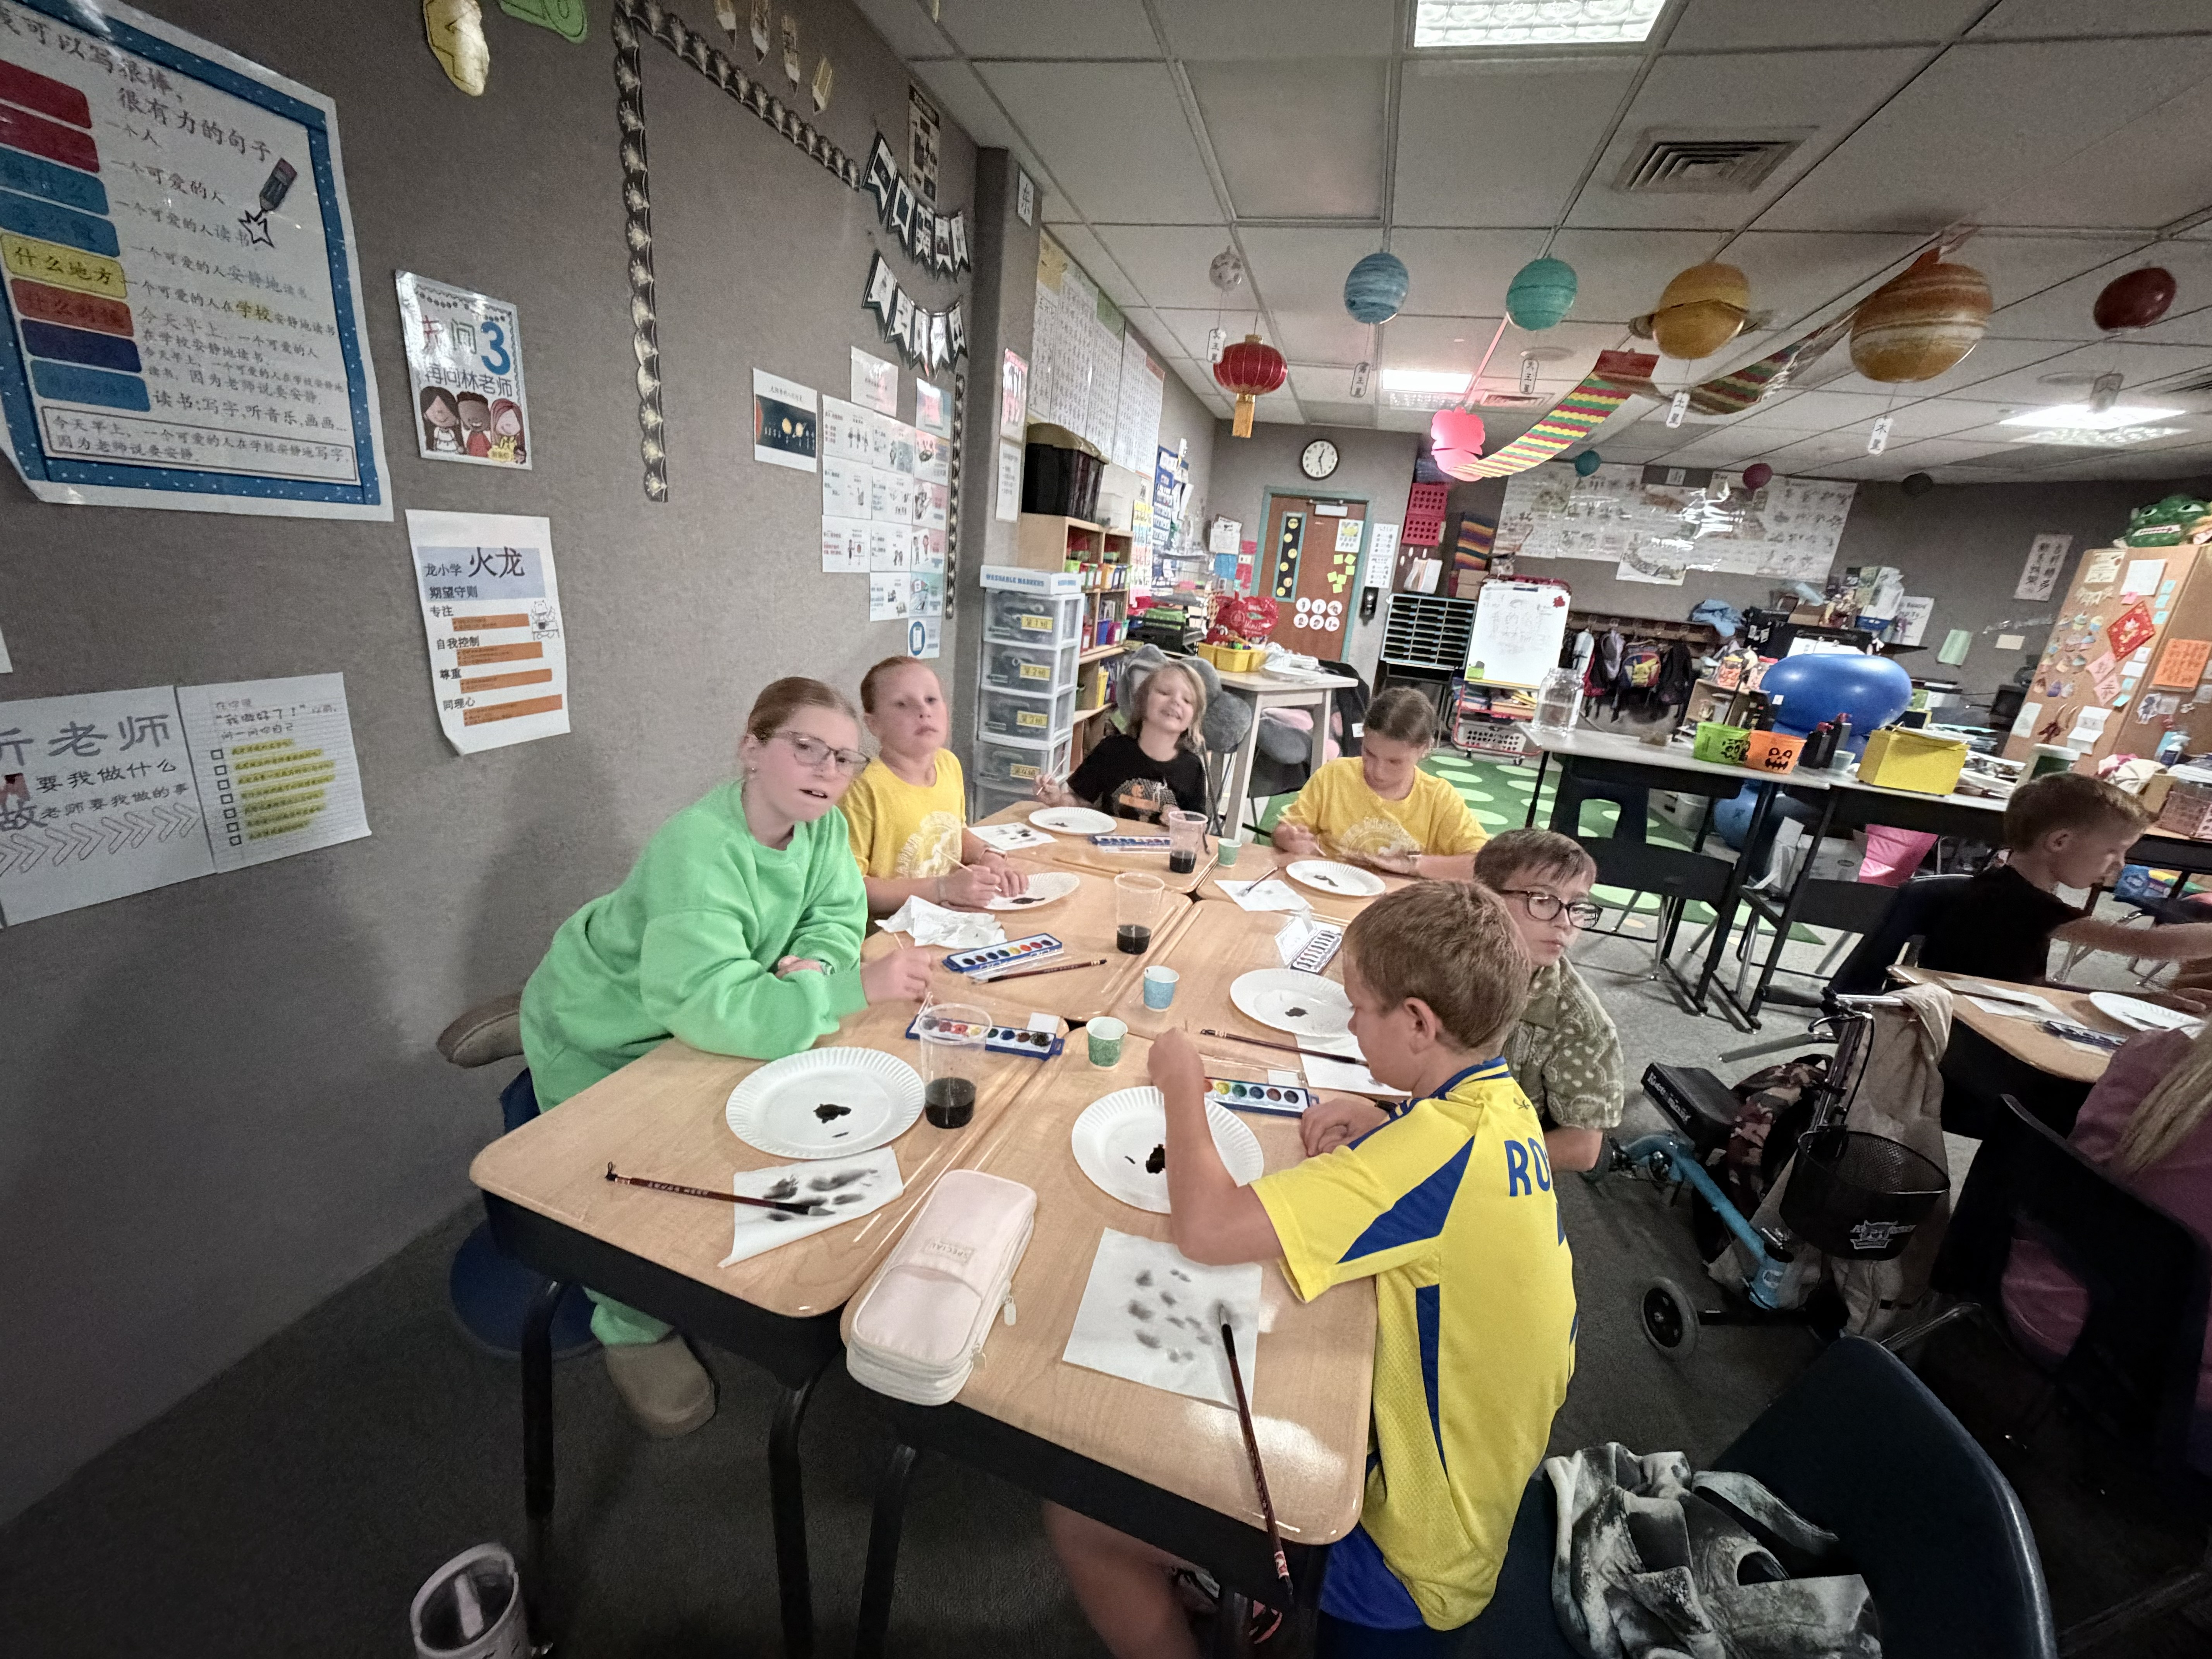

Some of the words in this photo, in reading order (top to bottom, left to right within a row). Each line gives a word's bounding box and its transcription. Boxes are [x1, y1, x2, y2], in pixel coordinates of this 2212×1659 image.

[105, 120, 163, 149] 一个人
[119, 88, 271, 161] 很有力的句子
[111, 160, 226, 205] 一个可爱的人
[15, 247, 111, 285] 什么地方
[425, 363, 512, 398] 再问林老师
[1870, 423, 1887, 451] 木星
[468, 546, 526, 578] 火龙
[429, 585, 478, 599] 期望守则
[430, 605, 454, 618] 专注
[436, 635, 480, 650] 自我控制
[440, 668, 462, 680] 尊重
[443, 699, 476, 711] 同理心
[36, 758, 177, 794] 要我做什么
[41, 782, 189, 820] 老师要我做的事
[1504, 1137, 1550, 1197] RO
